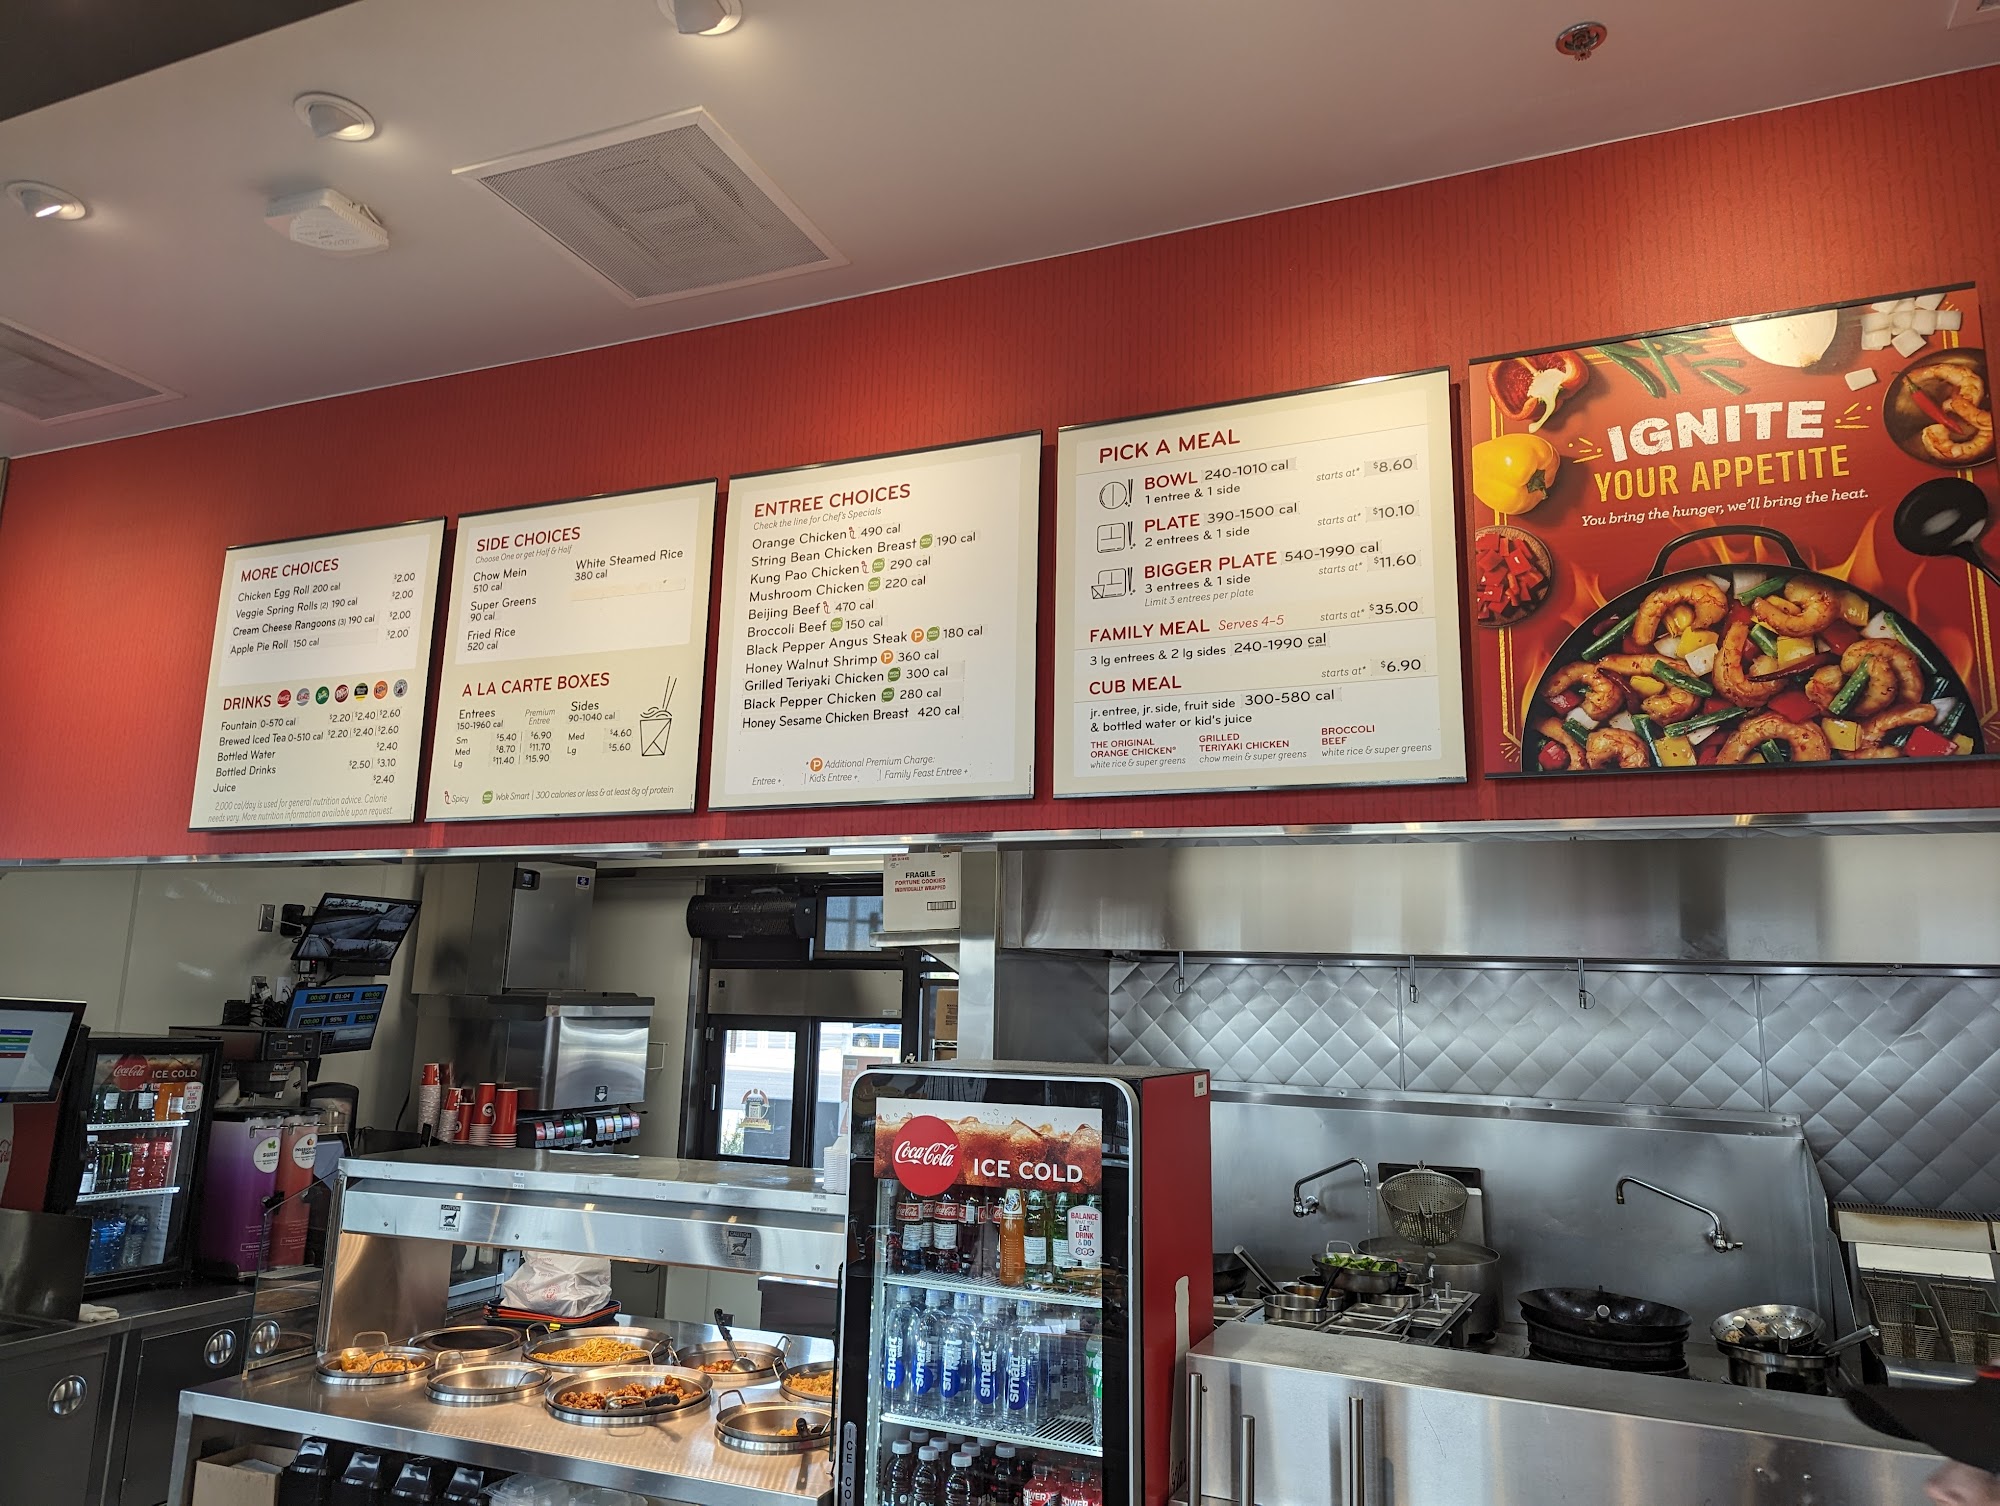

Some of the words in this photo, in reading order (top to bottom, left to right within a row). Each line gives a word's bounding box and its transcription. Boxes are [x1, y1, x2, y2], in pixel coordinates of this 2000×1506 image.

[1606, 400, 1826, 463] IGNITE
[1100, 442, 1148, 464] PICK
[1156, 439, 1171, 455] A
[1179, 429, 1240, 452] MEAL
[1145, 471, 1198, 490] BOWL
[1205, 462, 1268, 480] 240-1010
[1271, 459, 1288, 471] cal
[1316, 471, 1343, 481] starts
[1373, 458, 1413, 473] $8.60
[1593, 463, 1680, 502] YOUR
[1691, 445, 1849, 493] APPETITE
[755, 496, 823, 518] ENTREE
[829, 483, 910, 508] CHOICES
[1145, 495, 1150, 504] 1
[1154, 492, 1190, 503] entree
[1194, 488, 1203, 498] &
[1207, 486, 1212, 496] 1
[1217, 483, 1240, 495] side
[1317, 516, 1344, 526] starts
[1373, 504, 1415, 518] $10.10
[1581, 515, 1606, 527] You
[1608, 512, 1645, 524] bring
[1648, 507, 1669, 521] the
[1671, 503, 1724, 519] hunger,
[1727, 496, 1760, 512] we'll
[1762, 494, 1803, 509] bring
[1805, 489, 1828, 504] the
[1831, 486, 1869, 501] heat.
[1145, 513, 1200, 533] PLATE
[1207, 505, 1274, 524] 390-1500
[1279, 502, 1297, 514] cal
[477, 536, 510, 552] SIDE
[514, 526, 580, 547] CHOICES
[752, 538, 795, 550] Orange
[799, 530, 847, 544] Chicken
[860, 526, 883, 537] 490
[886, 523, 901, 534] cal
[576, 558, 606, 570] White
[609, 551, 656, 566] Steamed
[660, 549, 683, 560] Rice
[751, 555, 786, 567] String
[791, 552, 820, 563] Bean
[824, 545, 873, 559] Chicken
[877, 538, 917, 553] Breast
[937, 534, 957, 546] 190
[960, 531, 976, 543] cal
[241, 566, 279, 582] MORE
[282, 558, 339, 577] CHOICES
[1145, 559, 1212, 579] BIGGER
[1219, 551, 1277, 571] PLATE
[1285, 544, 1355, 562] 540-1990
[1360, 541, 1379, 554] cal
[1318, 565, 1346, 575] starts
[1374, 554, 1416, 568] $11.60
[473, 571, 500, 582] Chow
[503, 568, 527, 578] Mein
[238, 591, 271, 602] Chicken
[274, 588, 290, 600] Egg
[293, 585, 310, 595] Roll
[312, 584, 329, 593] 200
[330, 582, 341, 591] cal
[394, 572, 415, 583] $2.00
[473, 583, 489, 593] 510
[490, 581, 503, 591] cal
[749, 589, 812, 602] Mushroom
[816, 582, 864, 595] Chicken
[885, 577, 908, 589] 220
[911, 575, 926, 586] cal
[470, 601, 499, 612] Super
[502, 597, 536, 608] Greens
[1320, 612, 1348, 622] starts
[1369, 601, 1418, 615] $35.00
[747, 623, 794, 638] Broccoli
[799, 620, 827, 633] Beef
[846, 619, 865, 629] 150
[868, 617, 883, 628] cal
[1090, 624, 1154, 643] FAMILY
[1160, 619, 1210, 636] MEAL
[1218, 619, 1258, 631] Serves
[1261, 614, 1284, 626] 4-5
[230, 643, 254, 656] Apple
[256, 642, 270, 651] Pie
[272, 639, 288, 649] Roll
[293, 638, 307, 648] 150
[308, 637, 320, 646] cal
[746, 663, 783, 675] Honey
[786, 658, 829, 671] Walnut
[833, 655, 878, 667] Shrimp
[898, 651, 921, 662] 360
[924, 649, 939, 660] cal
[1321, 669, 1349, 678] starts
[1381, 659, 1421, 672] $6.90
[462, 684, 472, 697] A
[477, 682, 496, 696] LA
[501, 677, 552, 694] CARTE
[557, 672, 610, 690] BOXES
[1089, 680, 1126, 695] CUB
[1132, 675, 1182, 692] MEAL
[223, 695, 272, 711] DRINKS
[571, 700, 599, 712] Sides
[610, 728, 632, 737] $4.60
[1321, 725, 1375, 735] BROCCOLI
[1322, 736, 1347, 745] BEEF
[217, 750, 248, 762] Bottled
[250, 750, 276, 760] Water
[609, 742, 631, 752] $5.60
[216, 766, 247, 777] Bottled
[249, 764, 276, 775] Drinks
[349, 760, 371, 769] $2.50
[377, 758, 396, 768] $3.10
[824, 758, 865, 769] Additional
[865, 757, 902, 766] Premium
[903, 755, 935, 766] Charge:
[213, 783, 236, 793] Juice
[113, 1064, 146, 1077] Coca-Cola
[152, 1070, 168, 1079] ICE
[172, 1070, 197, 1078] COLD
[895, 1140, 958, 1167] Coca-Cola
[974, 1158, 1010, 1178] ICE
[1019, 1162, 1083, 1183] COLD
[1071, 1212, 1098, 1220] BALANCE
[887, 1336, 897, 1382] smart
[980, 1350, 992, 1397] smart
[1009, 1356, 1021, 1402] smart
